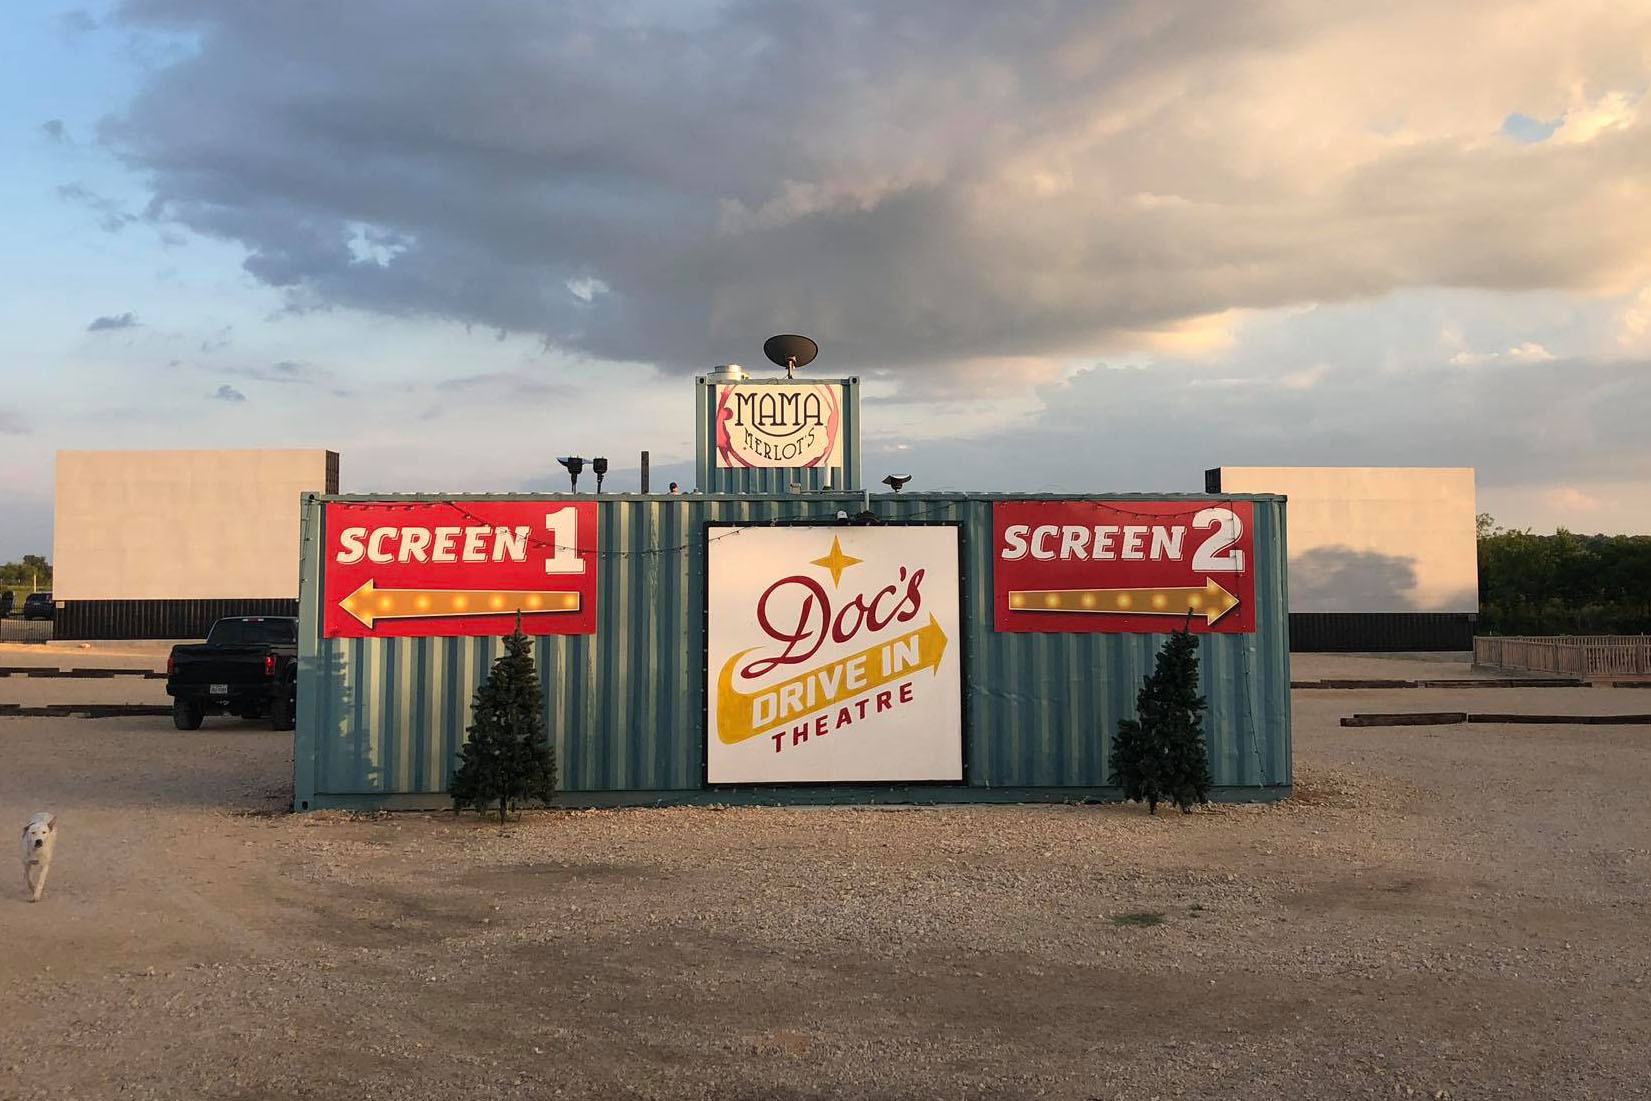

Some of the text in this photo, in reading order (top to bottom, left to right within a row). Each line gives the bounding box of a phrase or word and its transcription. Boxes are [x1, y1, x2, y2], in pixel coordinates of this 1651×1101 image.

[734, 392, 824, 437] MAMA
[744, 427, 815, 461] MERLOT'S
[336, 506, 586, 574] SCREEN 1
[1001, 507, 1246, 573] SCREEN 2
[740, 566, 925, 679] Doc's
[752, 634, 920, 729] DRIVE IN
[771, 681, 914, 753] THEATRE
